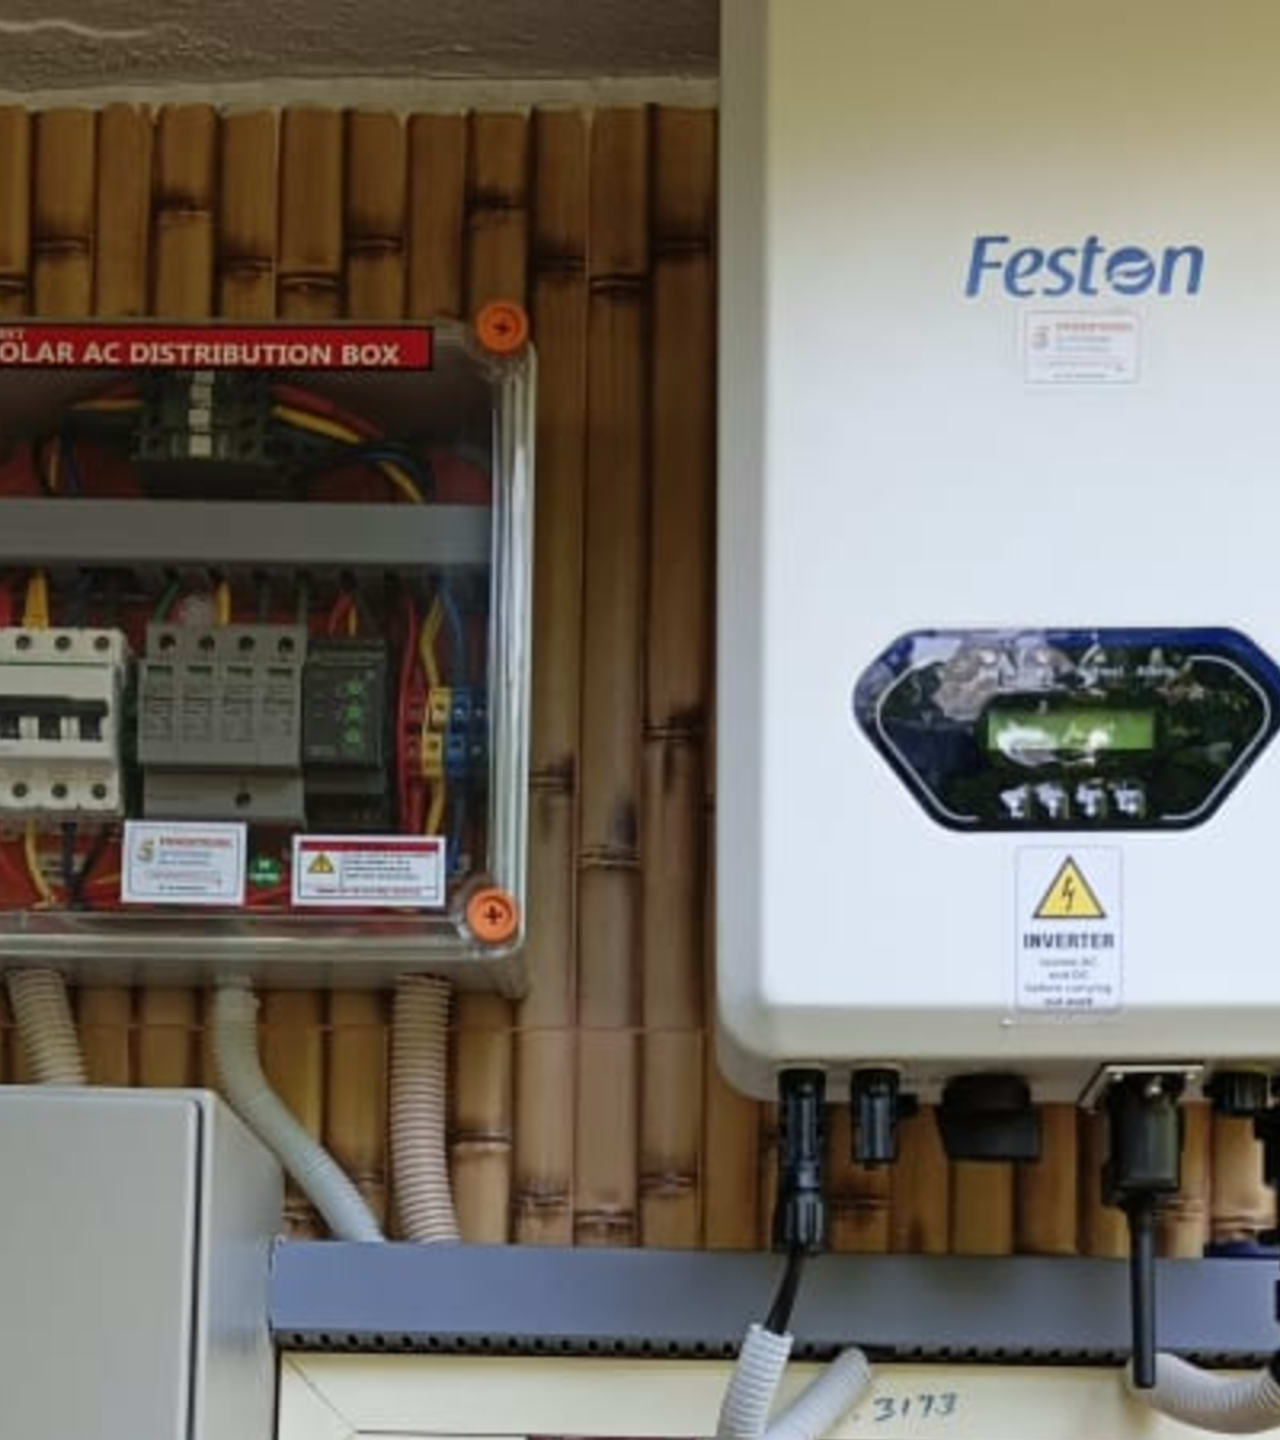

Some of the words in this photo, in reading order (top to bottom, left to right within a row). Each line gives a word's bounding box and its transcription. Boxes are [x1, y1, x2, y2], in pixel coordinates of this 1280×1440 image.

[964, 234, 1206, 299] Feston
[82, 341, 121, 364] AC
[130, 342, 332, 367] DISTRIBUTION
[342, 346, 401, 367] BOX
[1023, 932, 1114, 949] INVERTER
[873, 1392, 957, 1422] 3173
